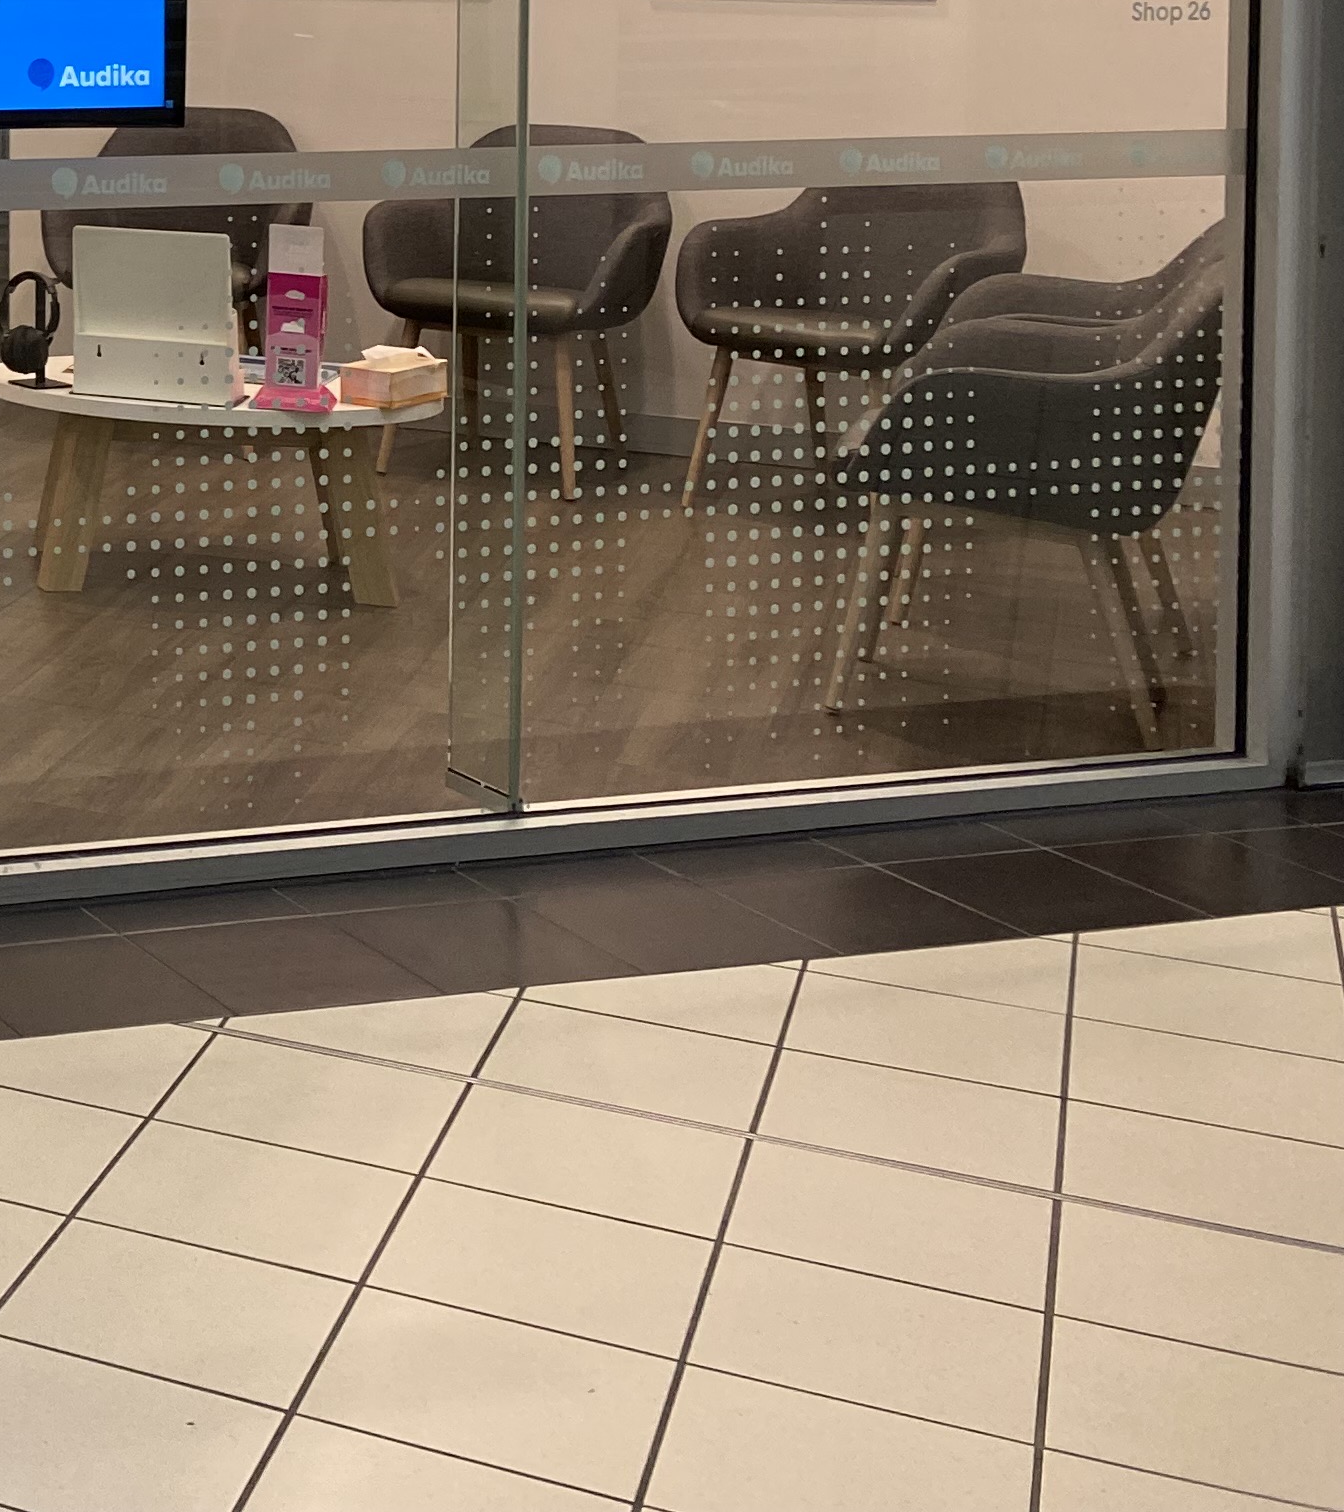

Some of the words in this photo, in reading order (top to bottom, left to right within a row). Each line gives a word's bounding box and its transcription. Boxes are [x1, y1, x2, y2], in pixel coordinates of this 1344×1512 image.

[1131, 1, 1182, 25] Shop
[1187, 1, 1211, 20] 26
[59, 64, 150, 87] Audika
[408, 164, 491, 187] Audika
[565, 159, 644, 182] Audika
[717, 155, 794, 177] Audika
[80, 172, 168, 197] Audika
[248, 168, 332, 191] Audika
